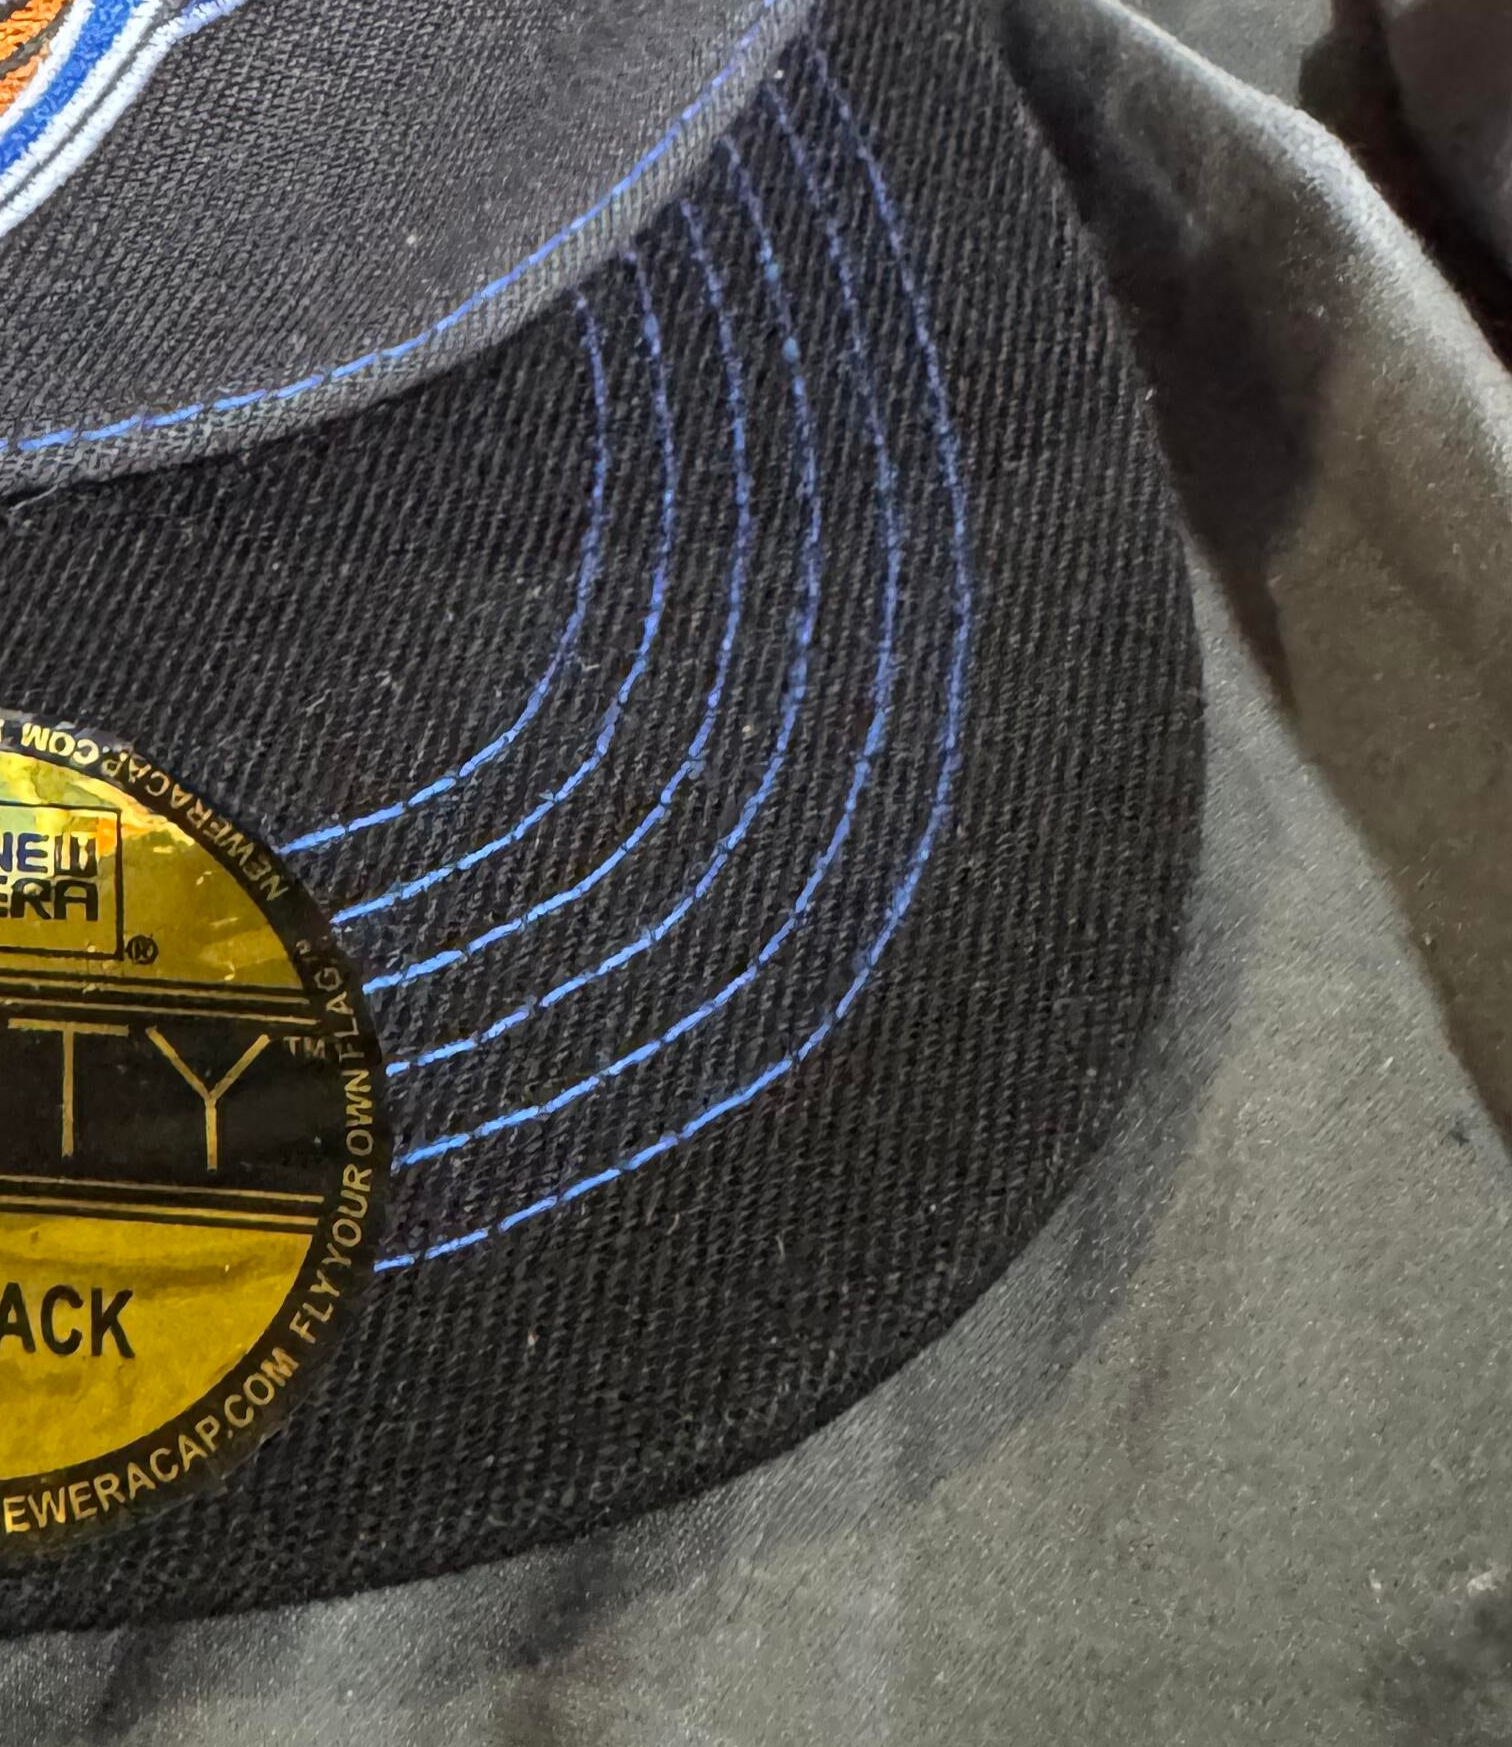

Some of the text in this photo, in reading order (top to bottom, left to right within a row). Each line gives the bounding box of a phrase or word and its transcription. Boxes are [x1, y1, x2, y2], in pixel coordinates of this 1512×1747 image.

[21, 721, 289, 902] NEWERACAP.COM
[344, 1067, 376, 1156] OWN
[322, 1163, 374, 1268] YOUR
[289, 1268, 342, 1345] FLY
